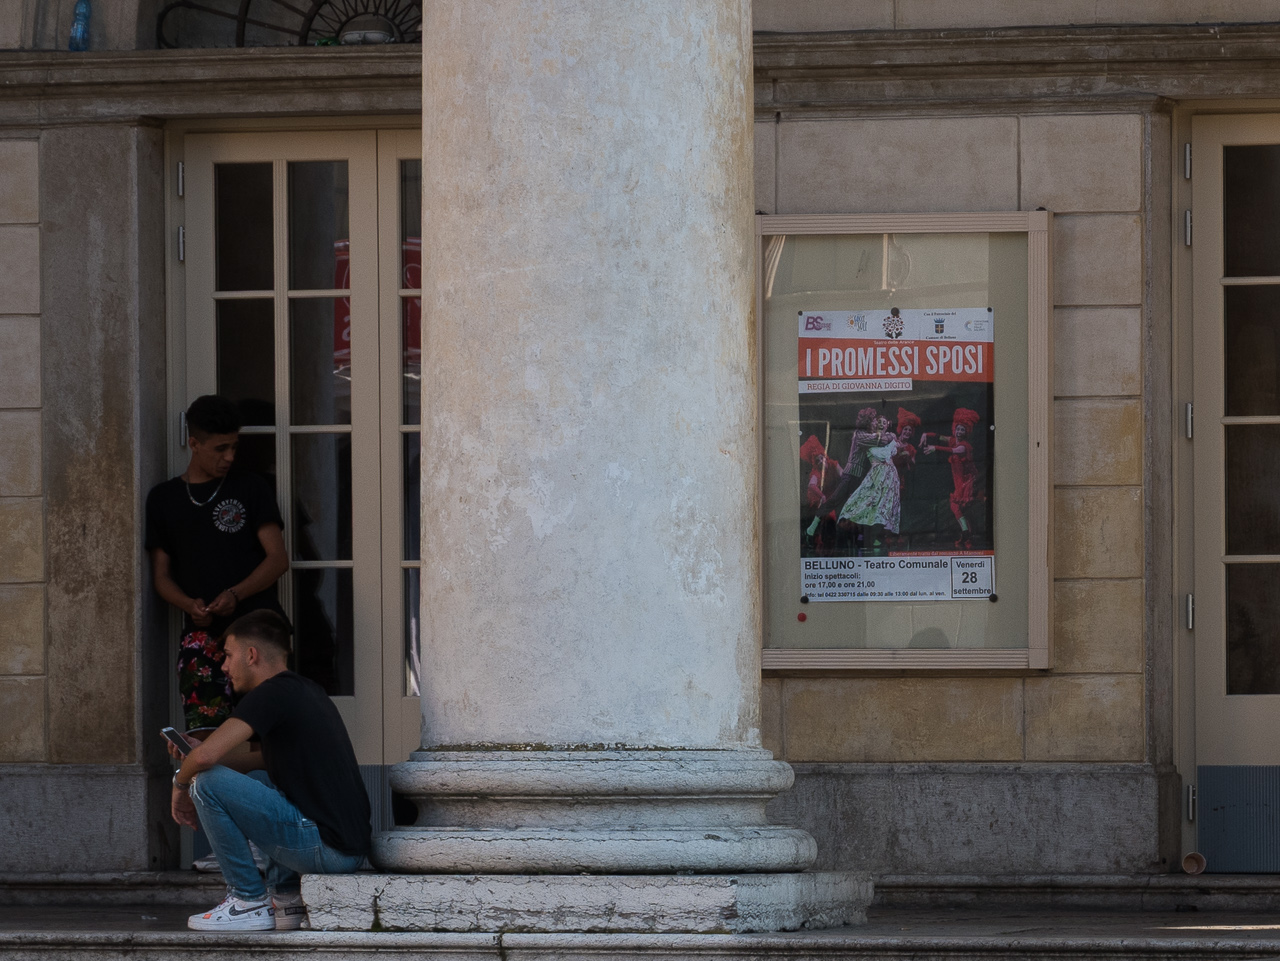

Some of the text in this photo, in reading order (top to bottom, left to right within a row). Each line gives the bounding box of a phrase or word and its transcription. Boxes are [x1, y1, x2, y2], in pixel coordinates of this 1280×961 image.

[806, 344, 983, 377] I PROMESSI SPOSI
[832, 382, 841, 390] DI
[841, 382, 883, 390] GIOVANNA
[884, 381, 911, 389] DIGITO
[804, 561, 855, 570] BELLUNO
[865, 560, 896, 570] Teatro
[898, 559, 949, 569] Comunale
[825, 572, 861, 580] spettacoli:
[962, 572, 978, 584] 28
[818, 581, 837, 589] 17,00
[953, 587, 992, 595] settembre
